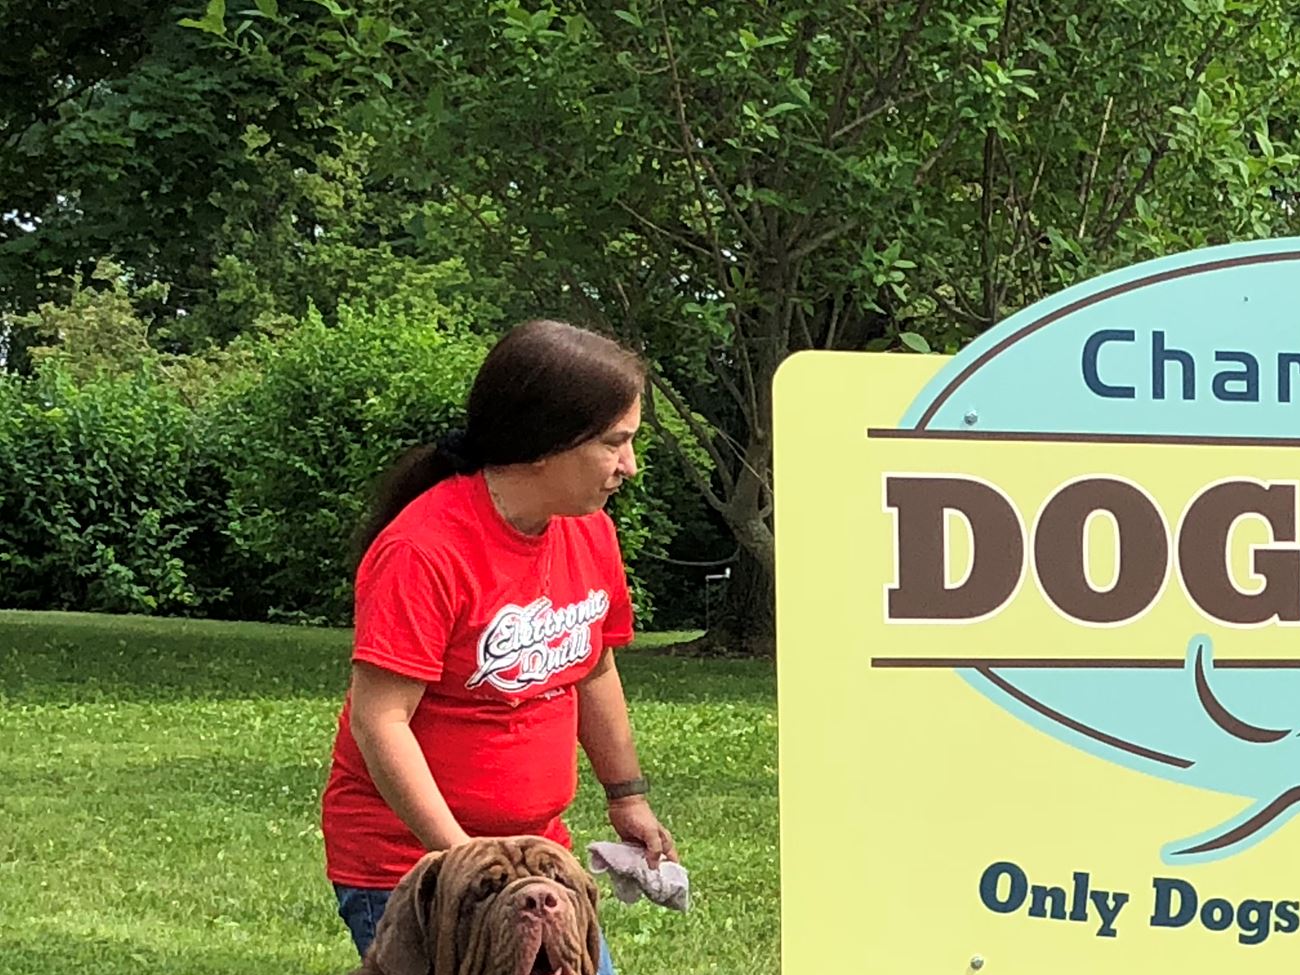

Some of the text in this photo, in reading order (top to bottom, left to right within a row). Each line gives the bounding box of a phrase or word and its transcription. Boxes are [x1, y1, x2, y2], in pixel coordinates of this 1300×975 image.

[517, 622, 591, 682] Quill
[979, 861, 1130, 938] Only
[1149, 877, 1300, 945] Dogs
